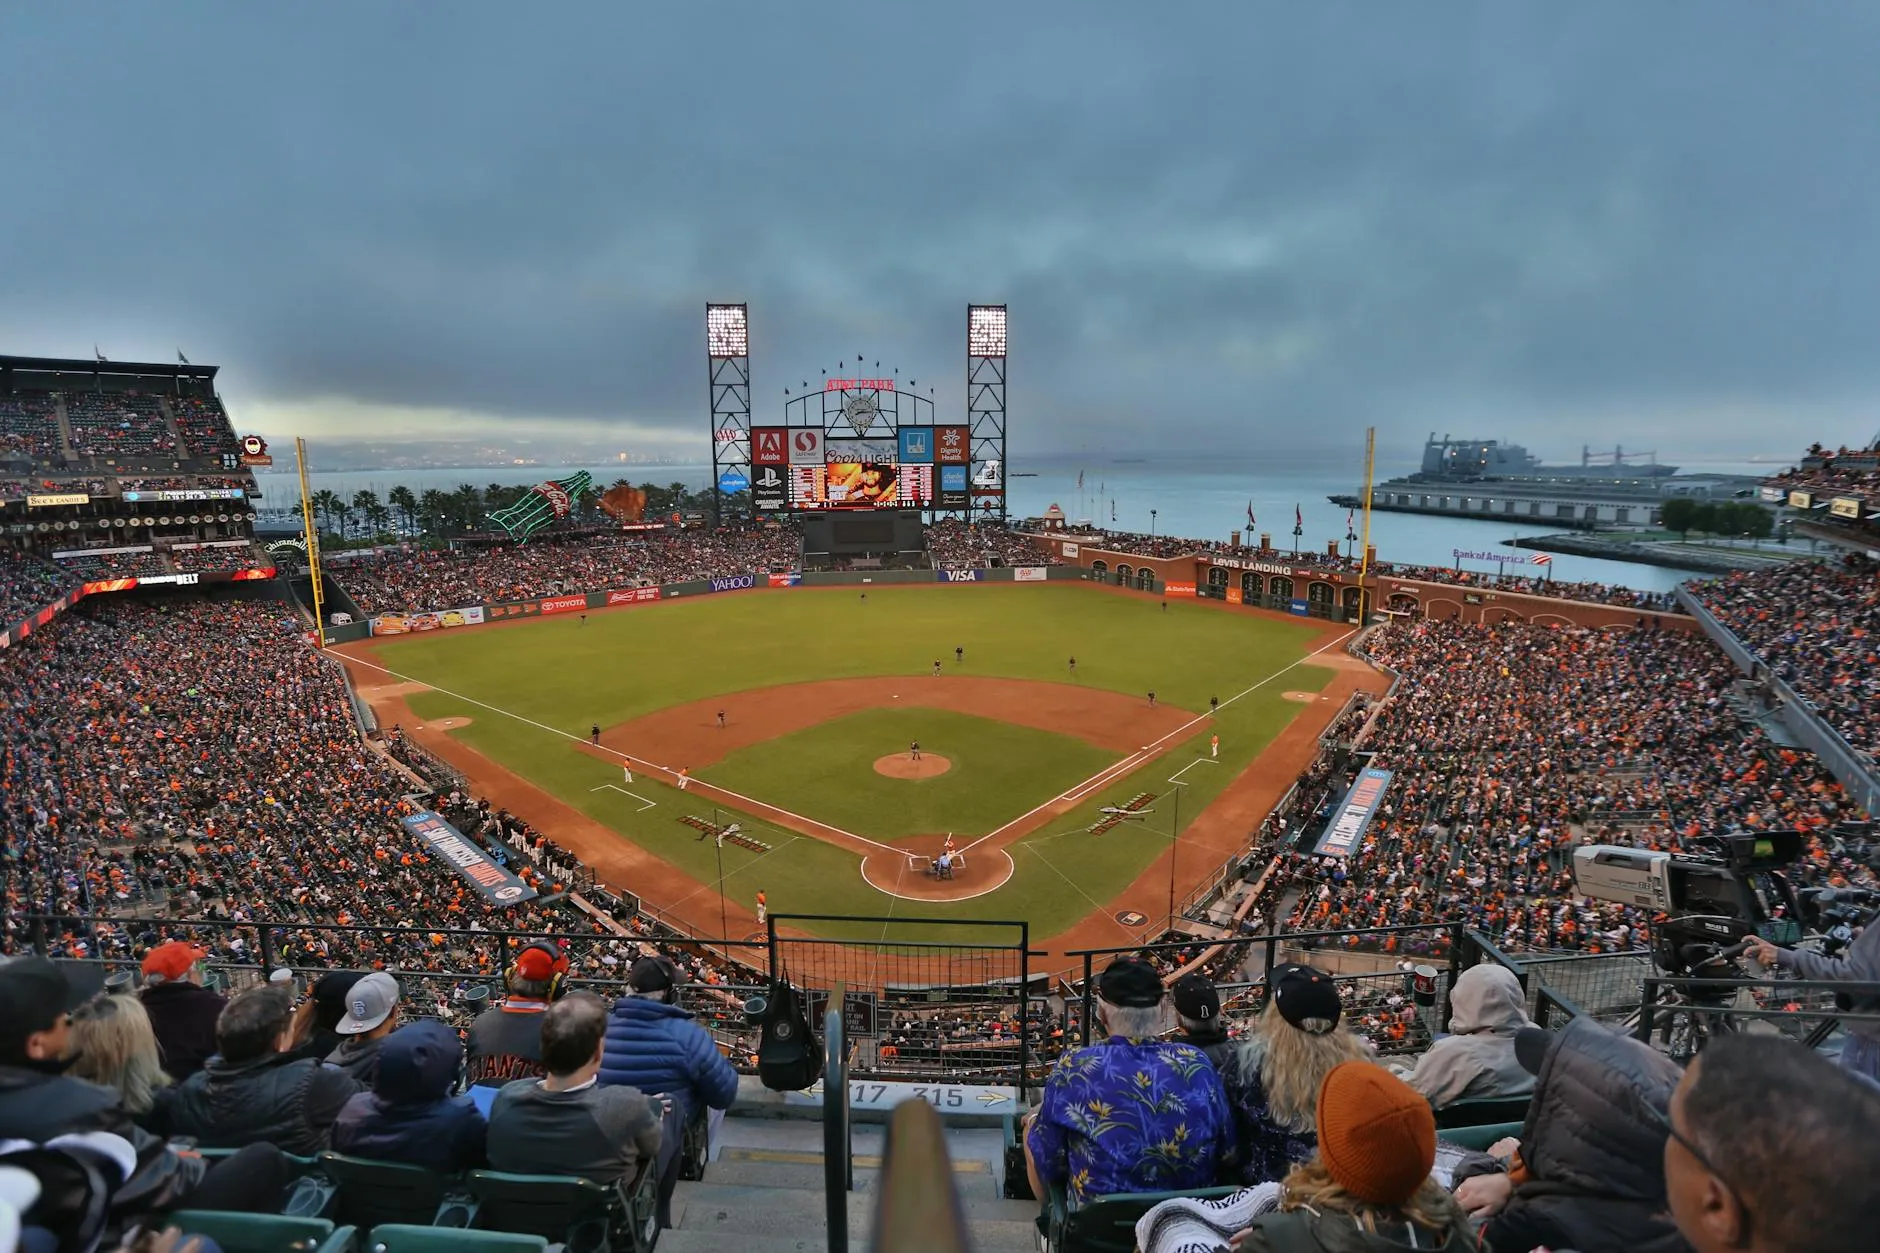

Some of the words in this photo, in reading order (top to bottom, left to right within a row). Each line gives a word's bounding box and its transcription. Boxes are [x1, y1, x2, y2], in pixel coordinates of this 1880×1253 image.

[861, 379, 894, 391] PARK
[760, 453, 780, 461] Adobe
[825, 449, 861, 463] Coors
[862, 454, 898, 463] LIGHT
[30, 497, 54, 505] See's
[264, 538, 306, 552] Ghirardelli
[1453, 549, 1475, 559] Bank
[1476, 551, 1486, 560] of
[1486, 551, 1525, 564] America
[1242, 561, 1292, 576] LANDING
[176, 573, 199, 585] BELT
[946, 571, 975, 581] VISA
[711, 575, 754, 592] YAHOO!
[554, 599, 586, 609] TOYOTA
[849, 1083, 888, 1103] 17
